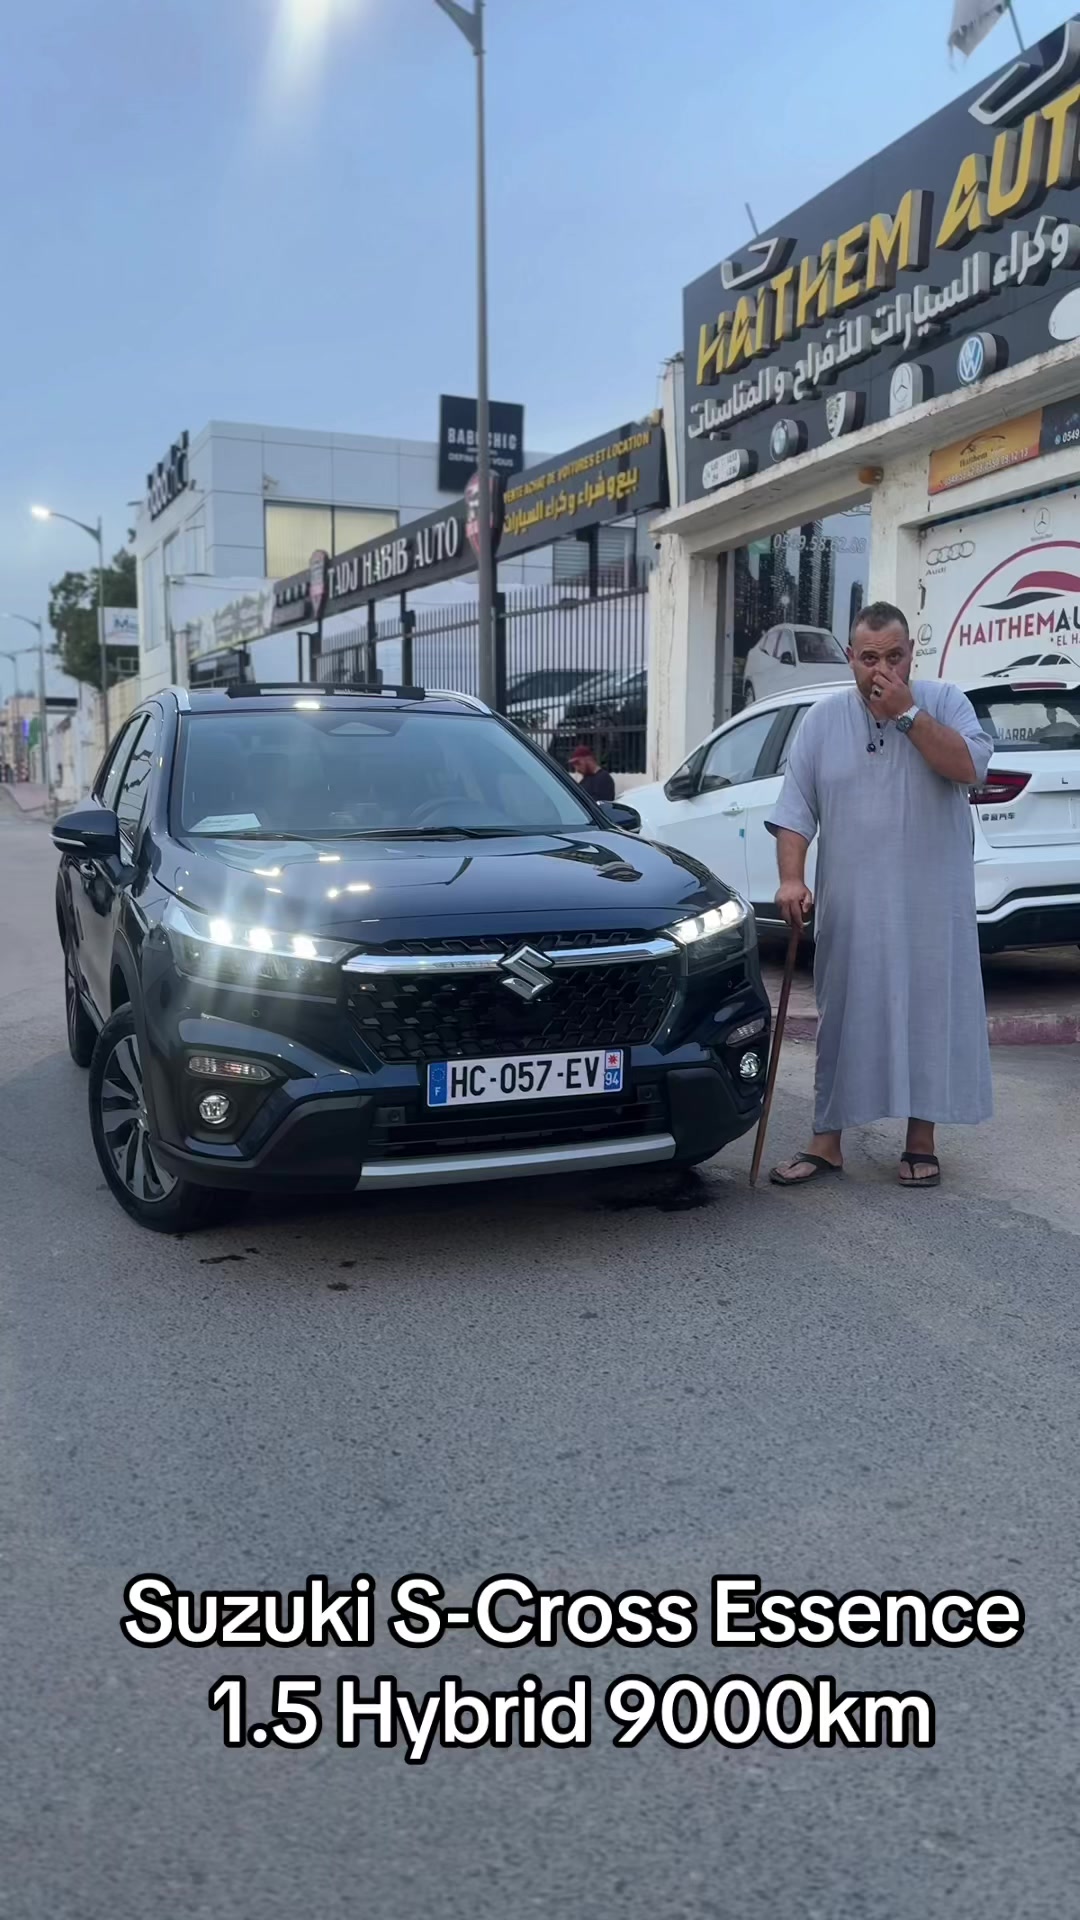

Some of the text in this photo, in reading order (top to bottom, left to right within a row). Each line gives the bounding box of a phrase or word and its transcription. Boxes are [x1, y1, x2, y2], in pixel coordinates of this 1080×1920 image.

[697, 189, 917, 385] HAITHEM
[871, 251, 989, 351] السيارات
[793, 314, 871, 400] للأفراح
[596, 448, 607, 465] ET
[607, 431, 651, 460] LOCATION
[328, 557, 358, 599] TADJ
[362, 537, 408, 587] HABIB
[413, 516, 458, 569] AUTO
[925, 566, 947, 576] Audi
[1057, 632, 1080, 646] EL H
[1061, 777, 1068, 785] L
[435, 1087, 440, 1096] F
[451, 1056, 599, 1098] HC-057-EV
[605, 1072, 619, 1086] 94
